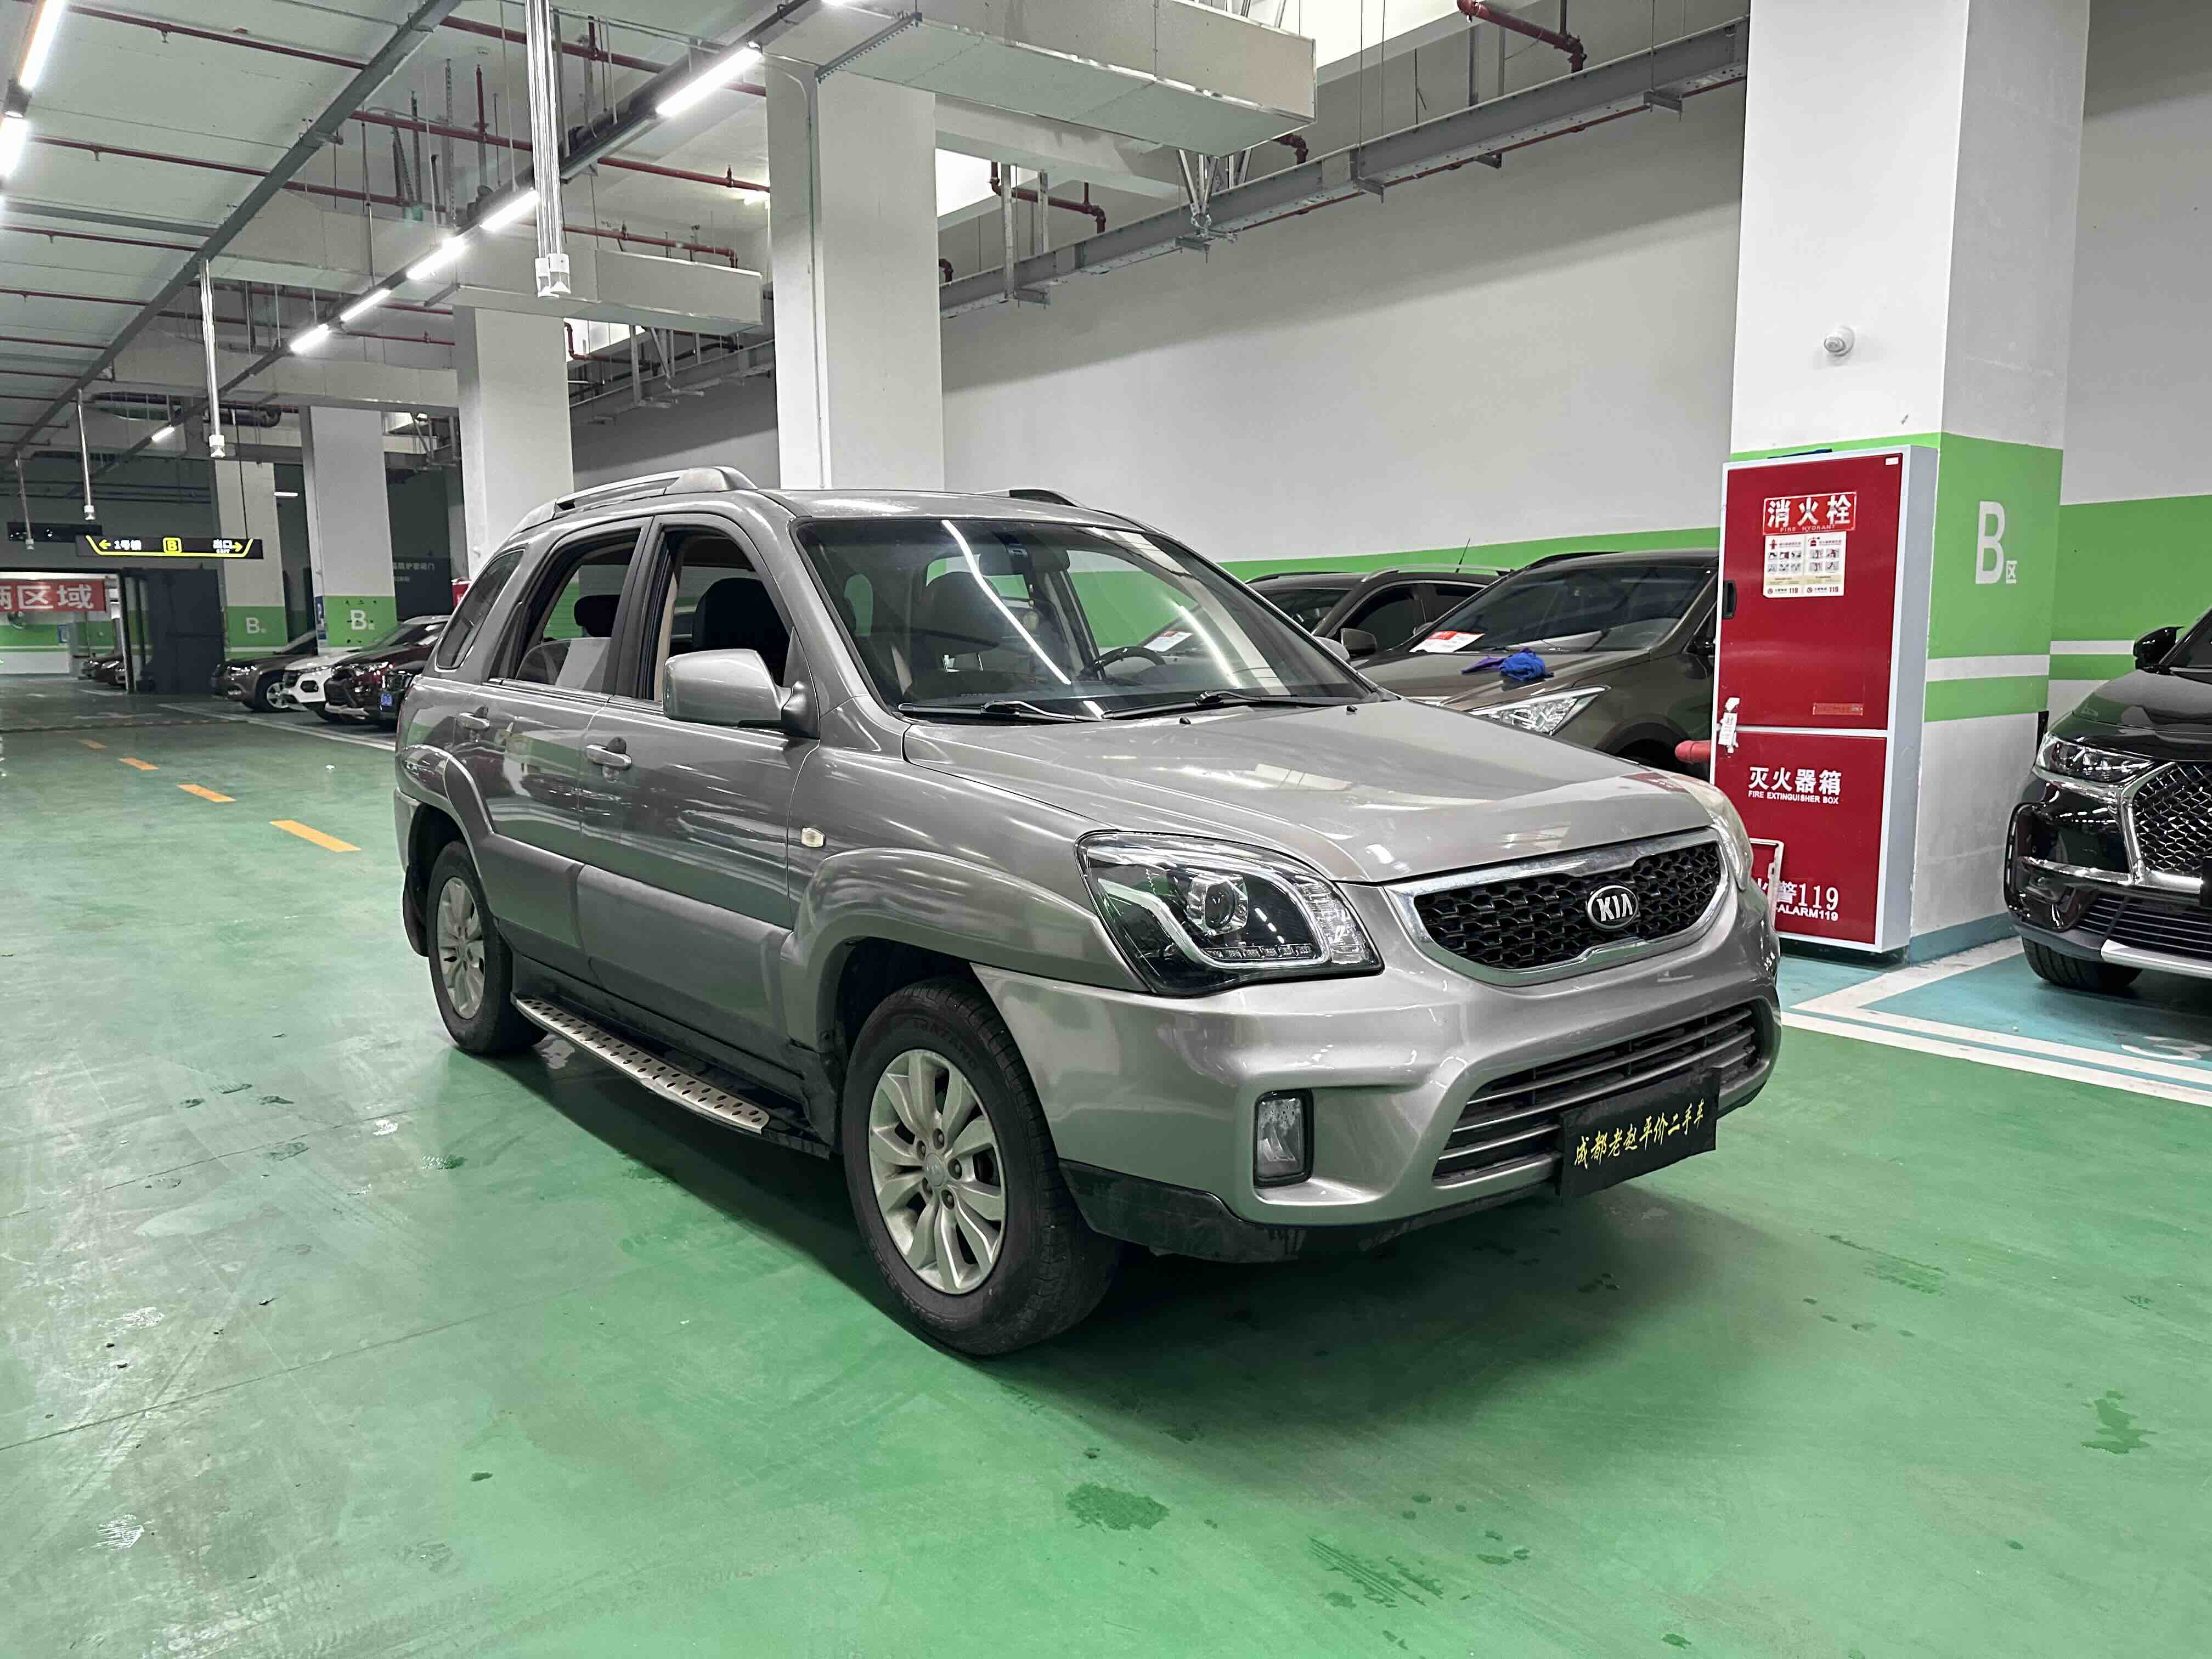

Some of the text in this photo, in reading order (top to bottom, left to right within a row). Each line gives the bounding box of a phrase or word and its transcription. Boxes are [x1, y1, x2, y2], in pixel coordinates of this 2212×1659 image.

[1768, 494, 1852, 527] 消火栓
[168, 540, 178, 550] B
[1975, 500, 2017, 584] B区
[1748, 766, 1842, 795] 灭火器箱
[1748, 790, 1839, 805] FIRE EXTINGUISHER BOX
[1596, 893, 1633, 922] KIA
[1574, 1098, 1705, 1170] 成都老赵平价二手车
